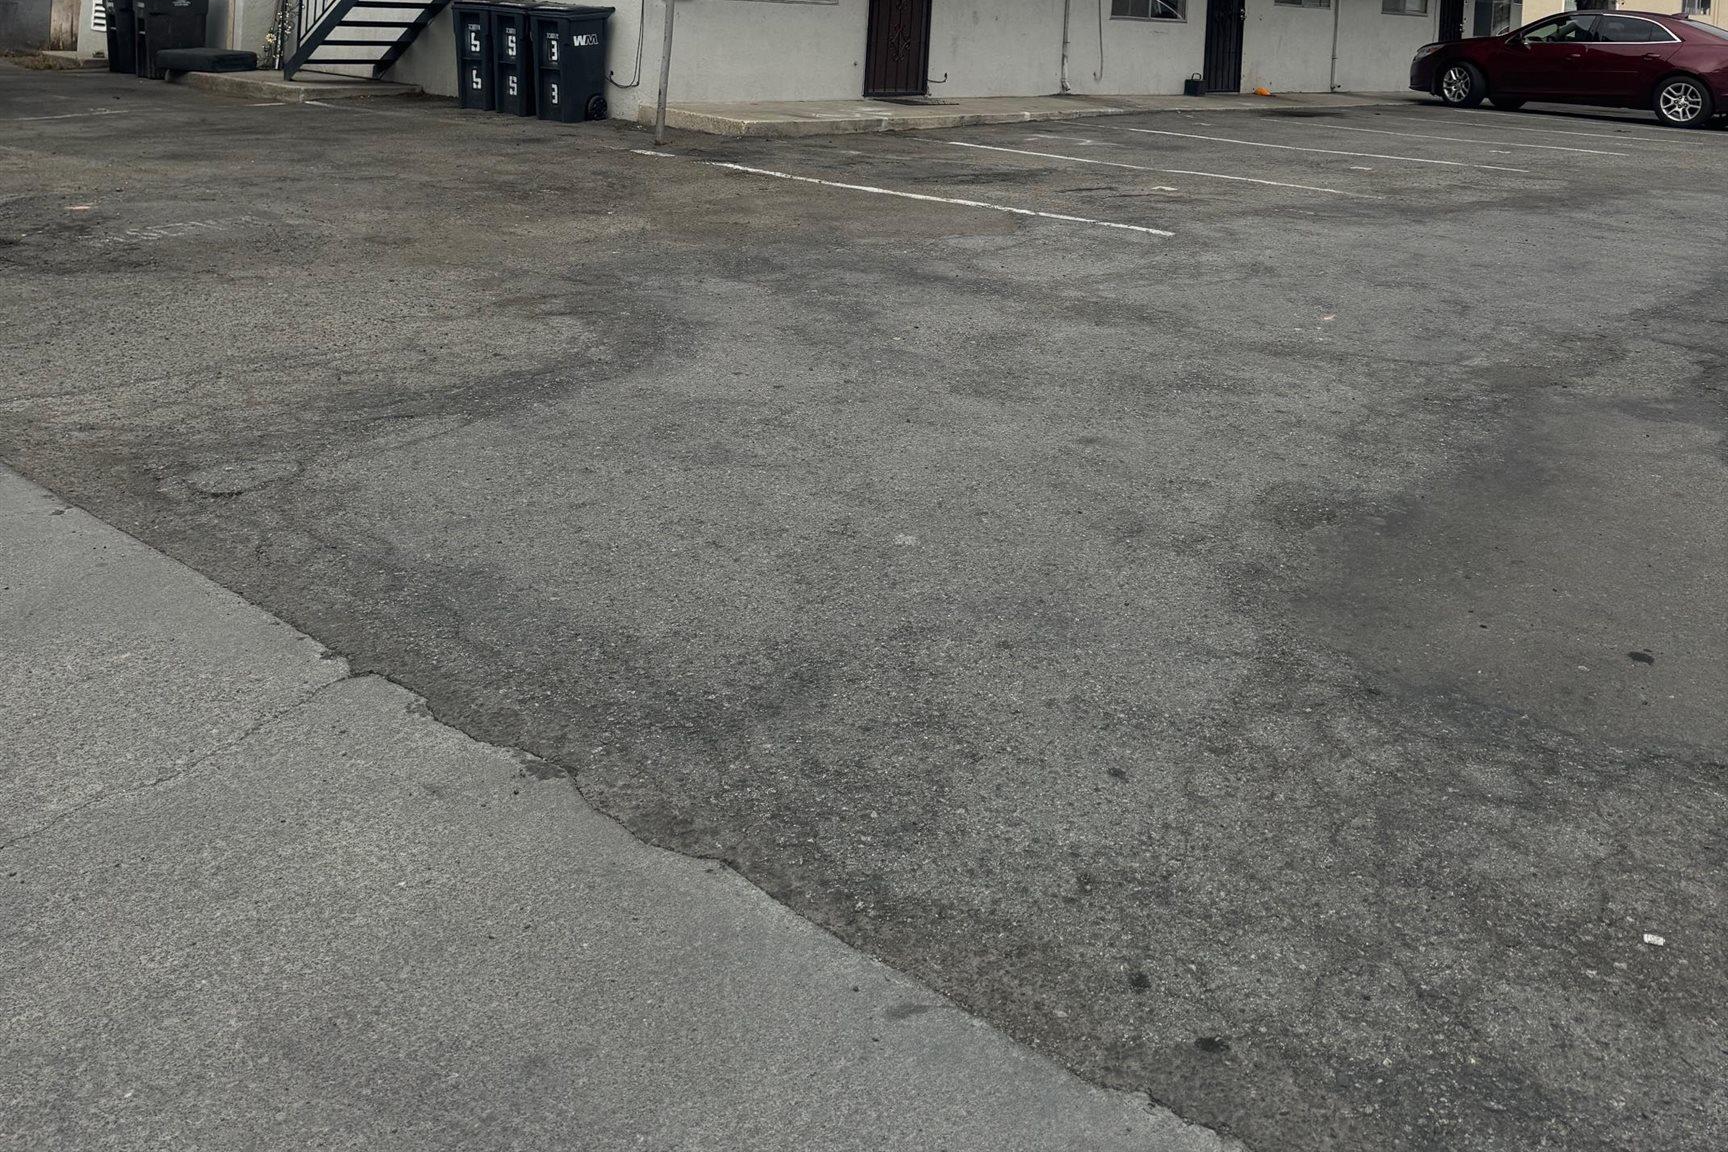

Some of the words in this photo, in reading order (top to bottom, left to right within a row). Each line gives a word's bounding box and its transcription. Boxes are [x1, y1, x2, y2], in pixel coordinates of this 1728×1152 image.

[573, 33, 599, 46] WM
[551, 40, 558, 61] 3
[551, 83, 558, 104] 3
